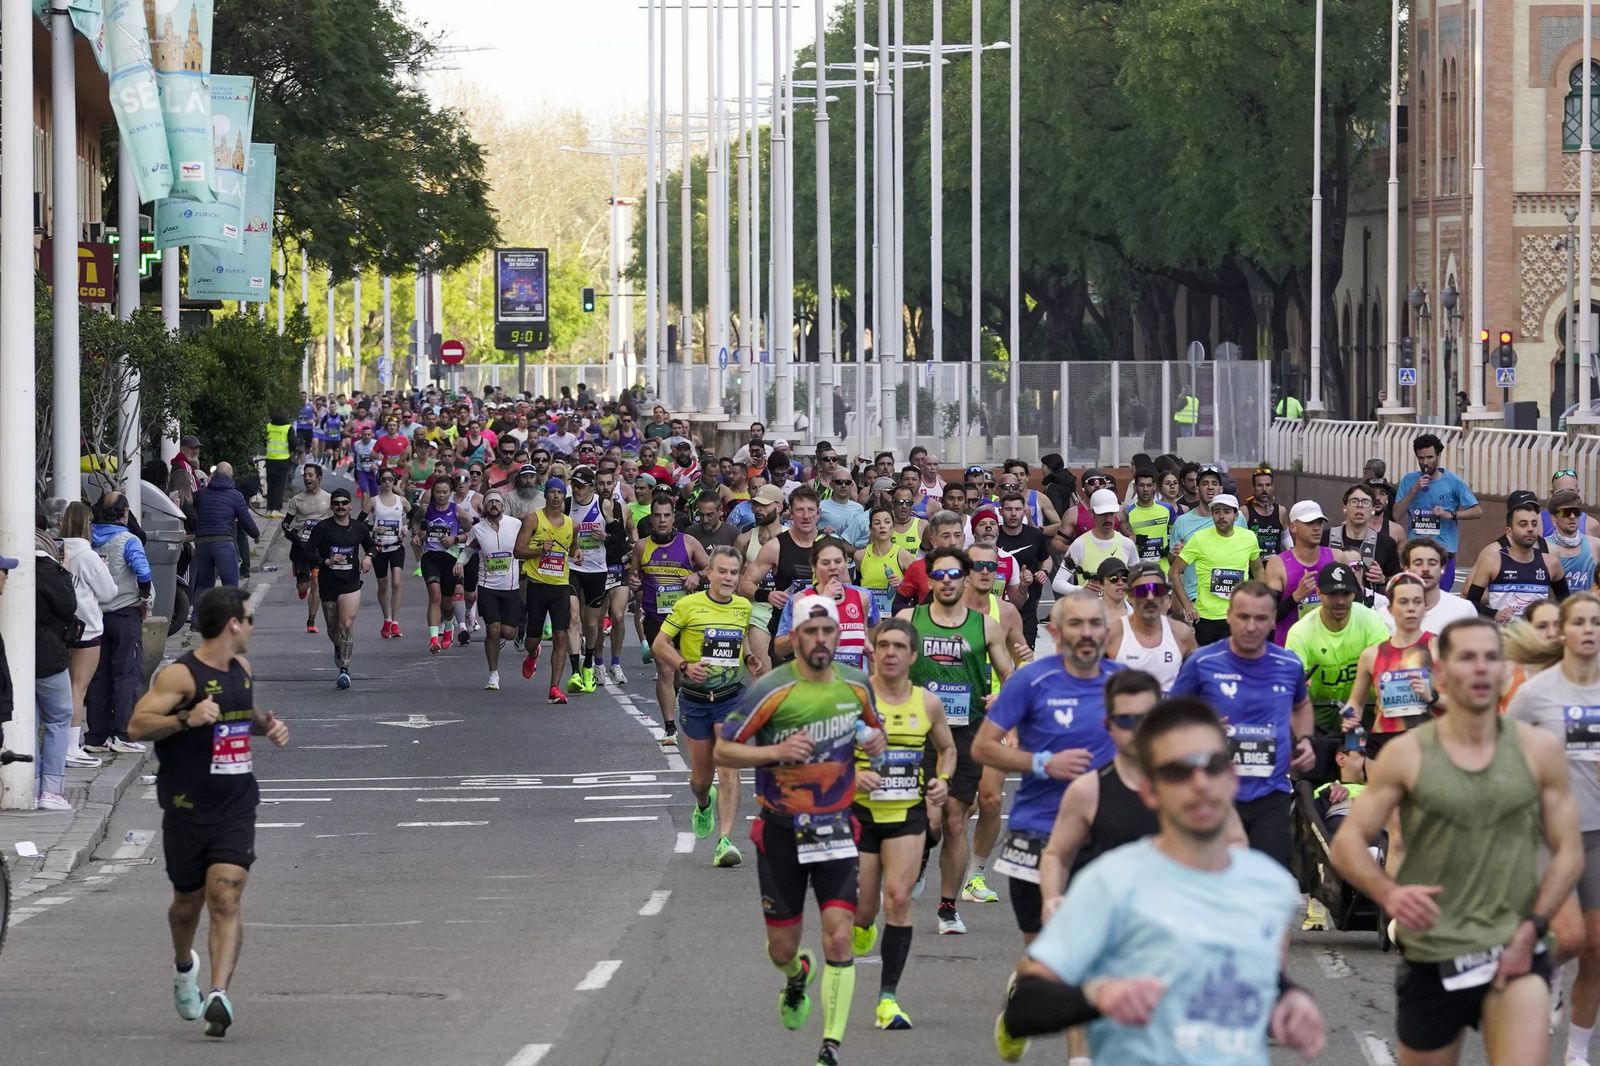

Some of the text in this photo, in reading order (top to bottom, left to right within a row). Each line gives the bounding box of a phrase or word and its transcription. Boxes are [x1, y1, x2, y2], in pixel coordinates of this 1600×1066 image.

[512, 330, 542, 342] 9:01
[713, 649, 733, 657] KAKU
[1383, 694, 1425, 706] MARGAU
[944, 704, 967, 714] ÉLIEN
[1239, 727, 1270, 735] ZURICH
[1244, 752, 1269, 764] BIGE
[880, 777, 916, 788] EDERICO
